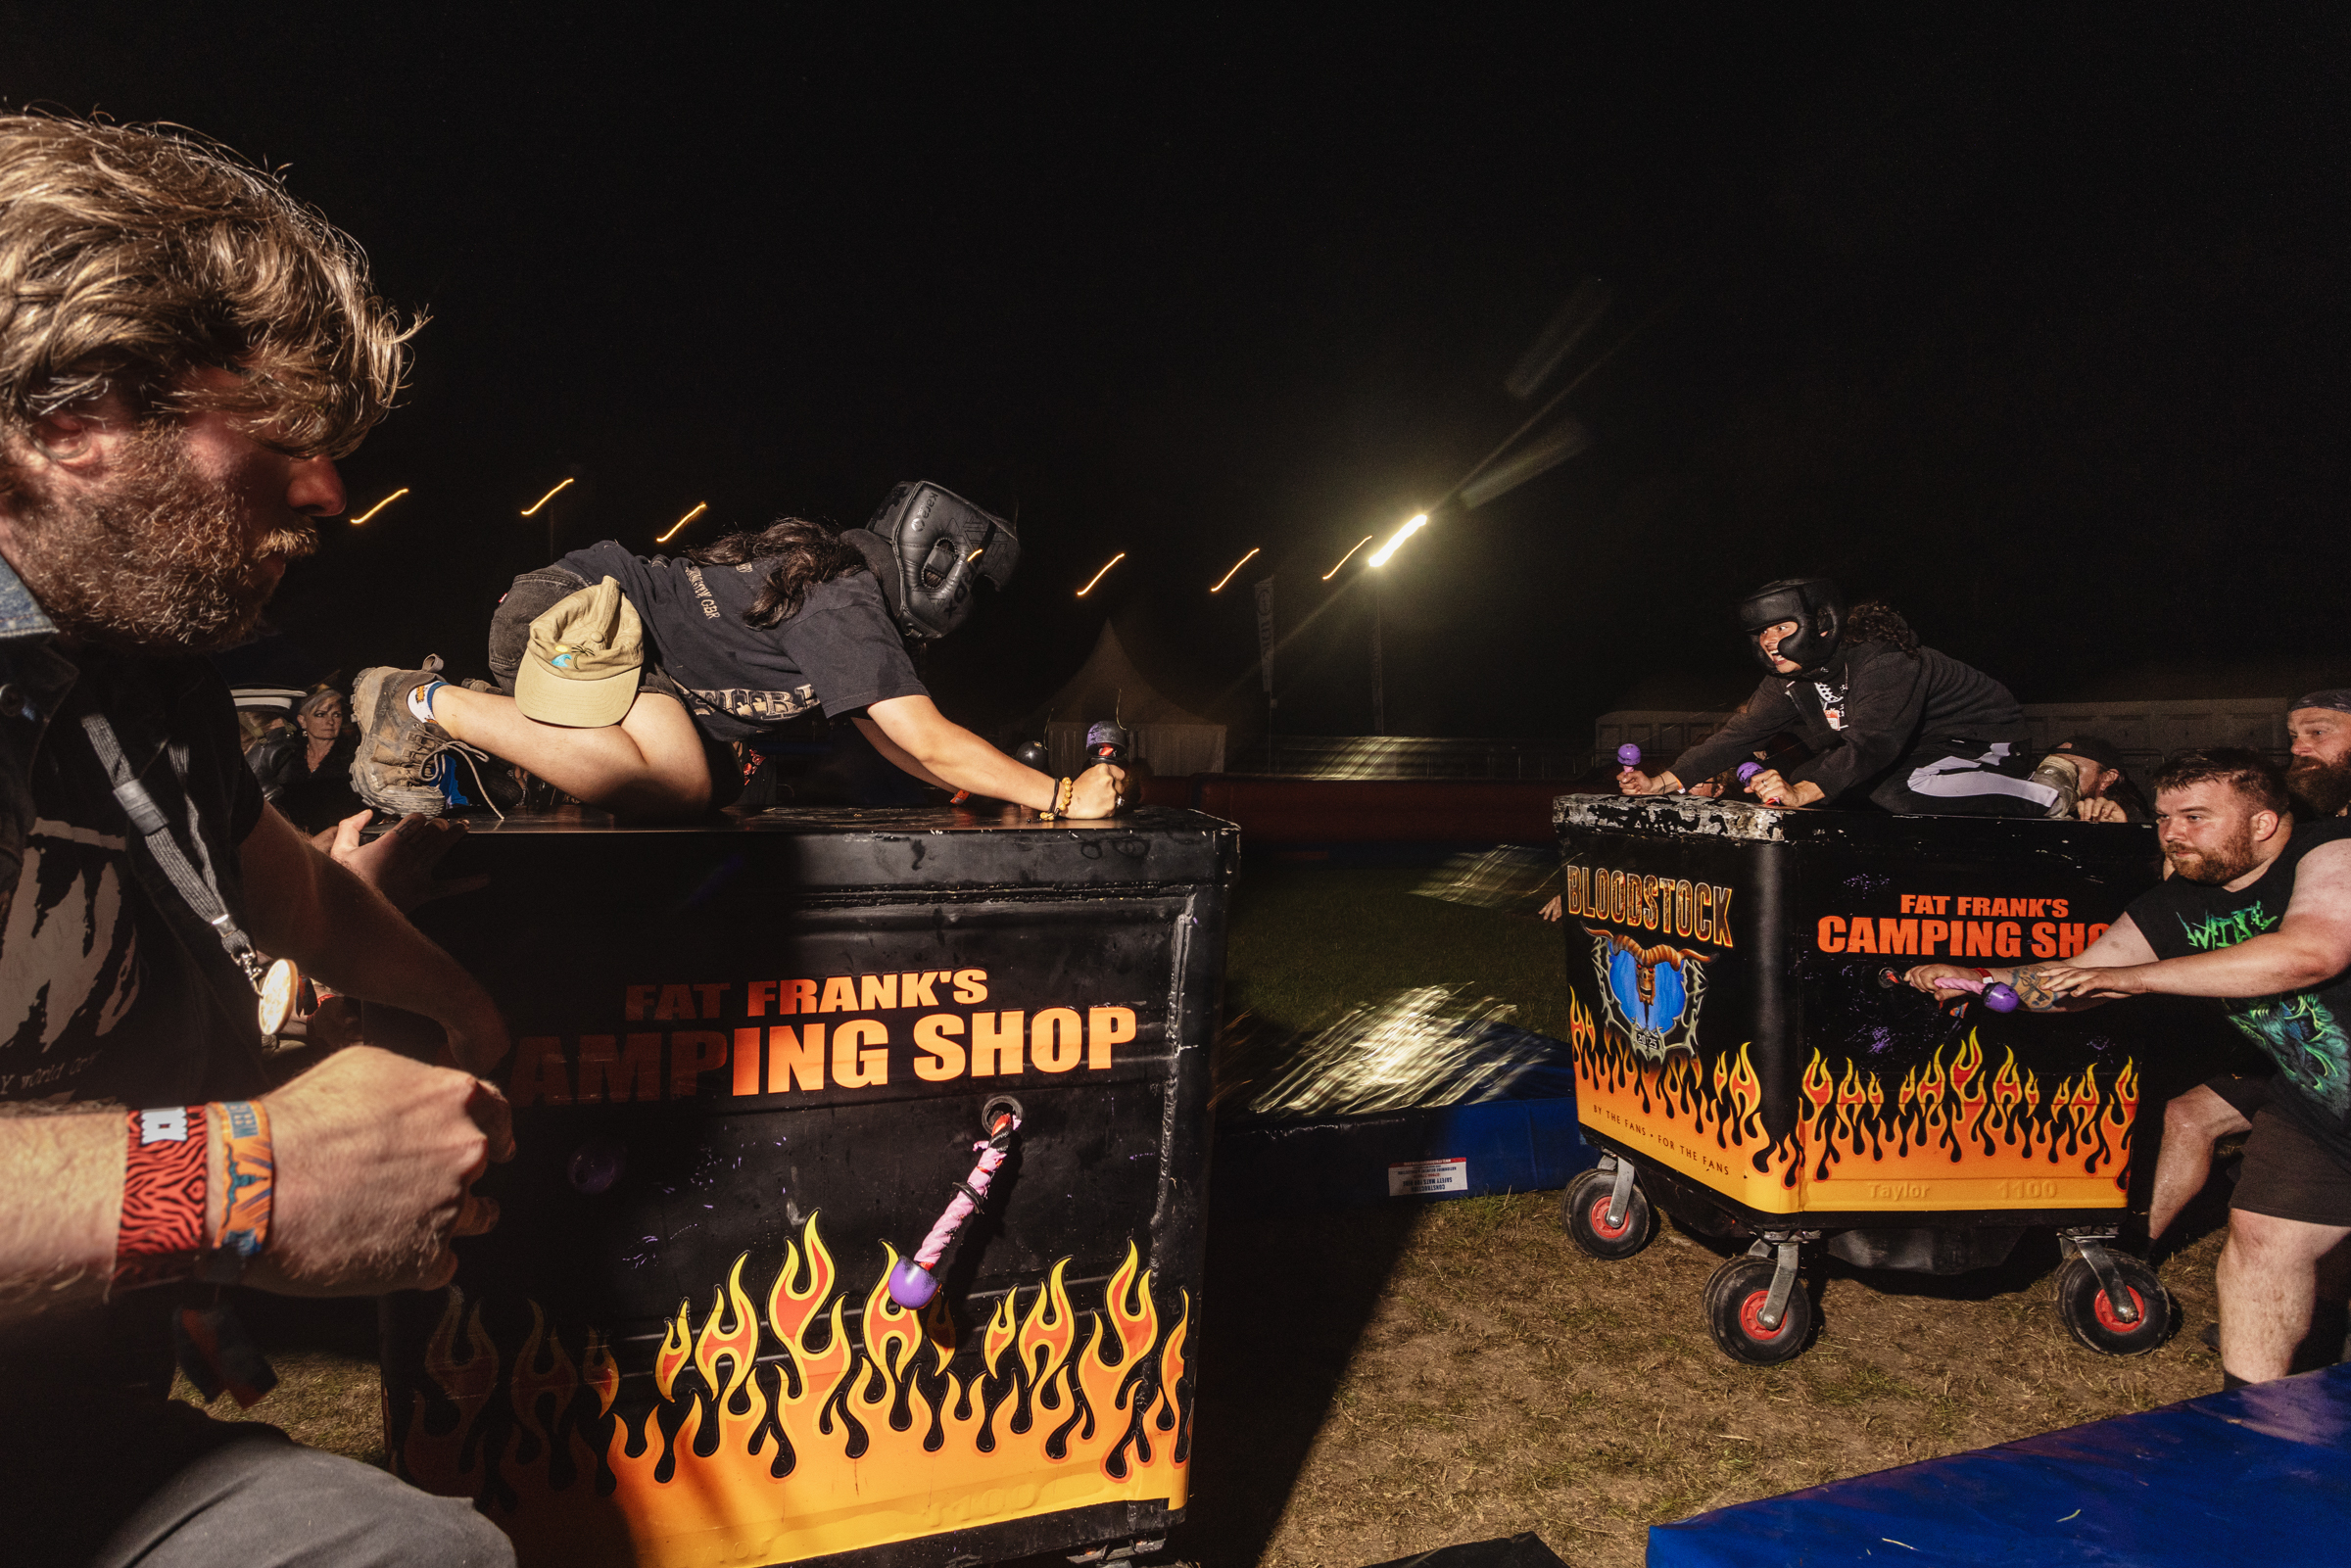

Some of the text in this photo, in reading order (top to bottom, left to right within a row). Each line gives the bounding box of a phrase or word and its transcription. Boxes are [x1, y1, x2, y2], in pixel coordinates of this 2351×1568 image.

[1567, 865, 1734, 948] BLOODSTOCK
[1900, 894, 2069, 918] FAT FRANK'S
[1817, 915, 2111, 958] CAMPING SHO
[625, 968, 988, 1022] FAT FRANK'S
[505, 1006, 1136, 1108] AMPING SHOP
[1593, 1104, 1730, 1175] BY THE FANS FOR THE FANS
[1868, 1180, 2058, 1202] Taylor 1100
